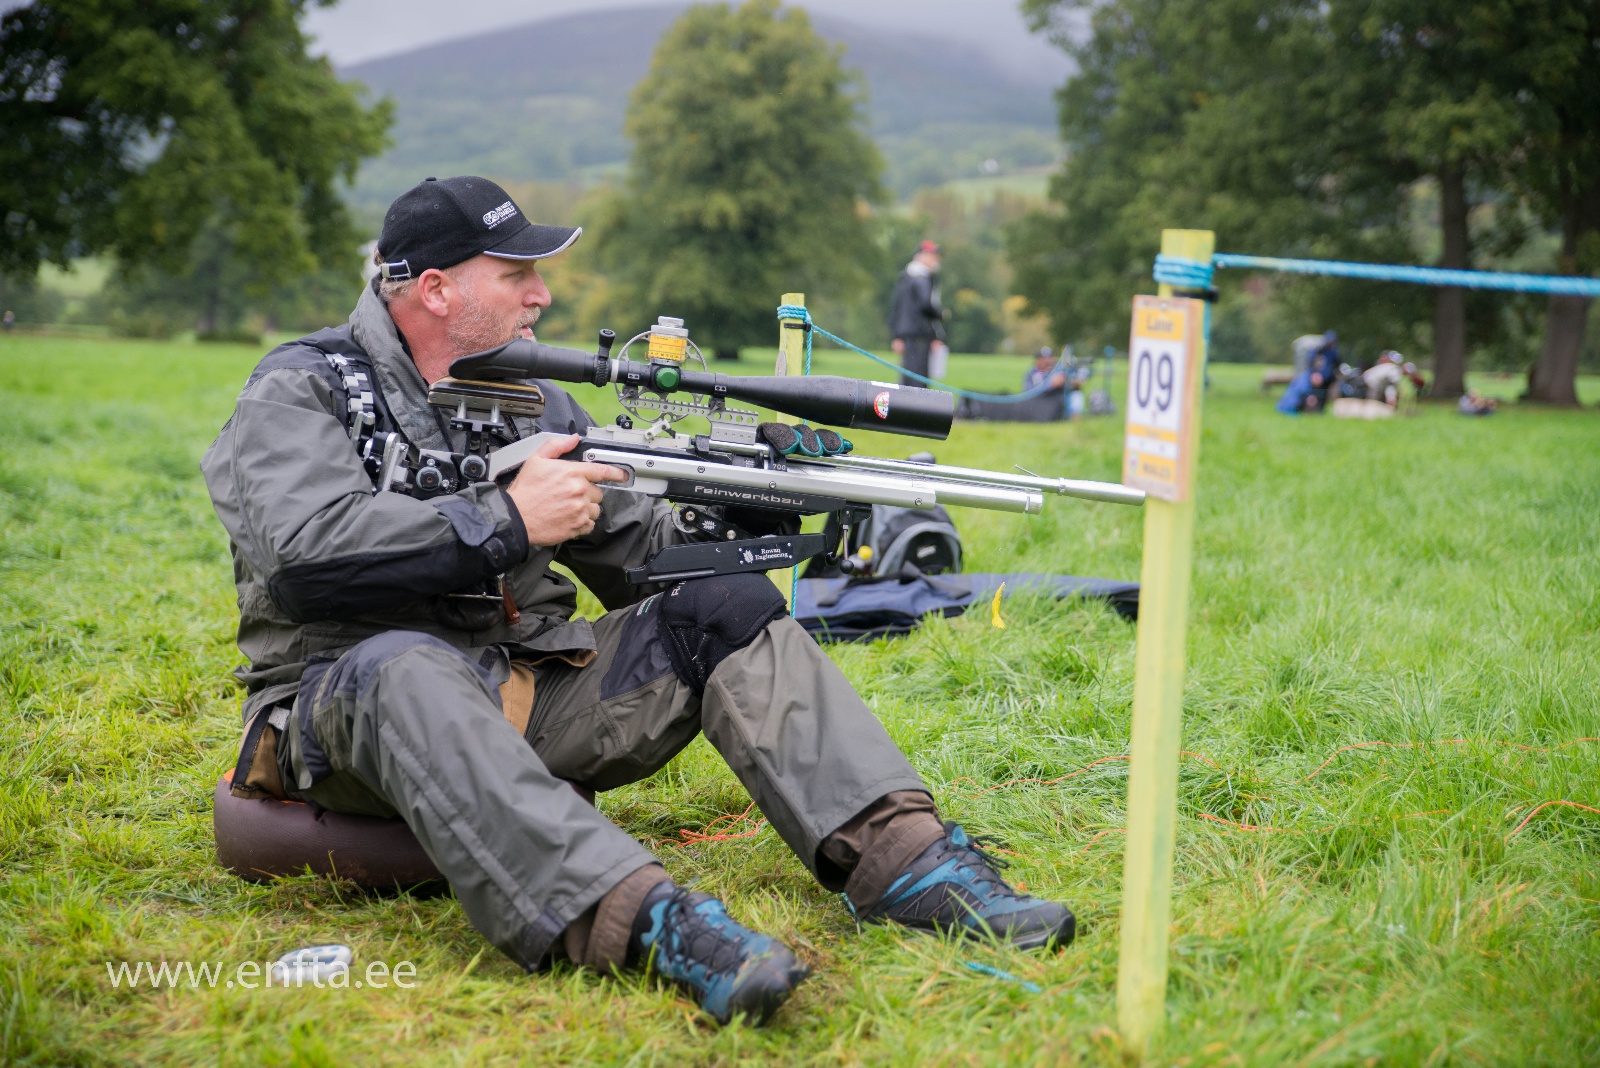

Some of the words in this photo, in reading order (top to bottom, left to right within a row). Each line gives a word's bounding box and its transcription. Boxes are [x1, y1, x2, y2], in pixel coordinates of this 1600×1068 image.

[1135, 349, 1175, 413] 09
[772, 463, 787, 471] 700
[760, 547, 781, 555] Rowan
[754, 552, 789, 561] Engineering
